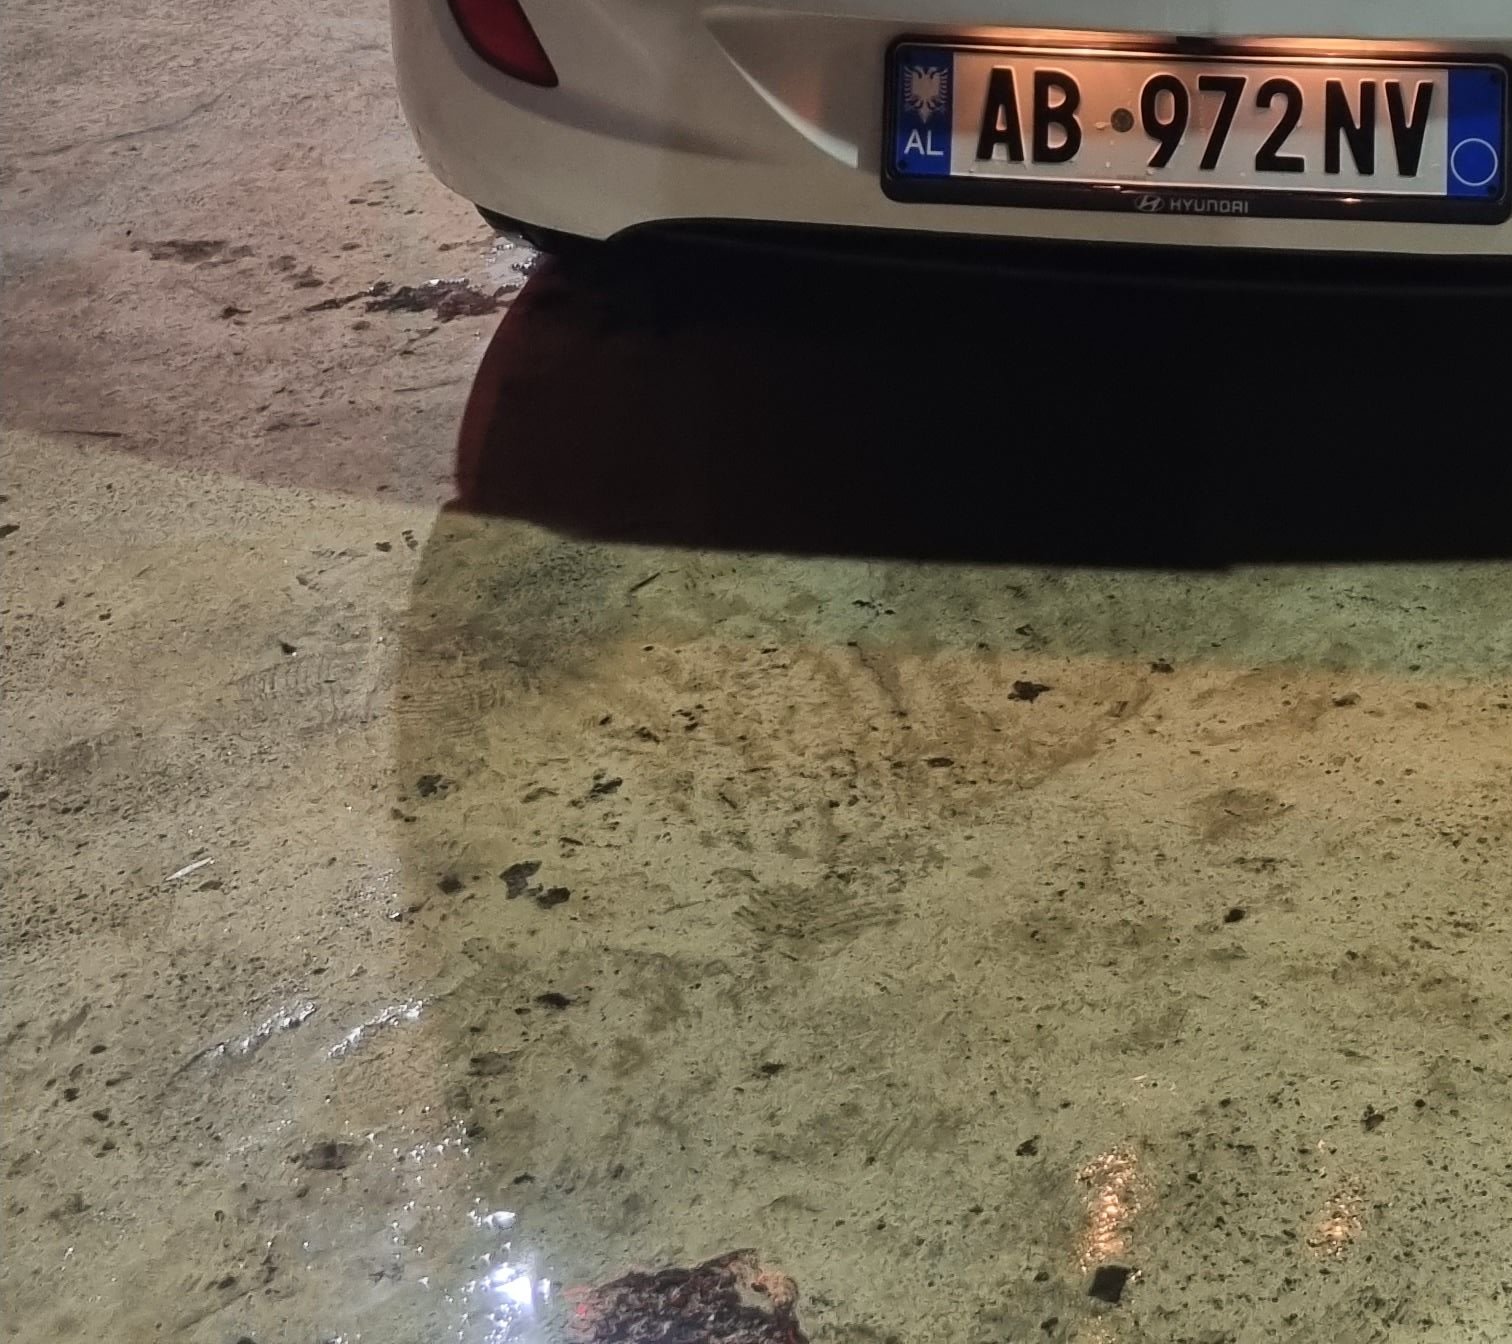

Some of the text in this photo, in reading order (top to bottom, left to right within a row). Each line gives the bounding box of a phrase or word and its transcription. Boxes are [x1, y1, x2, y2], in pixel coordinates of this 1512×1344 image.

[975, 66, 1434, 178] AB 972 NV
[903, 128, 945, 156] AL
[1169, 198, 1249, 214] HYUNDAI
